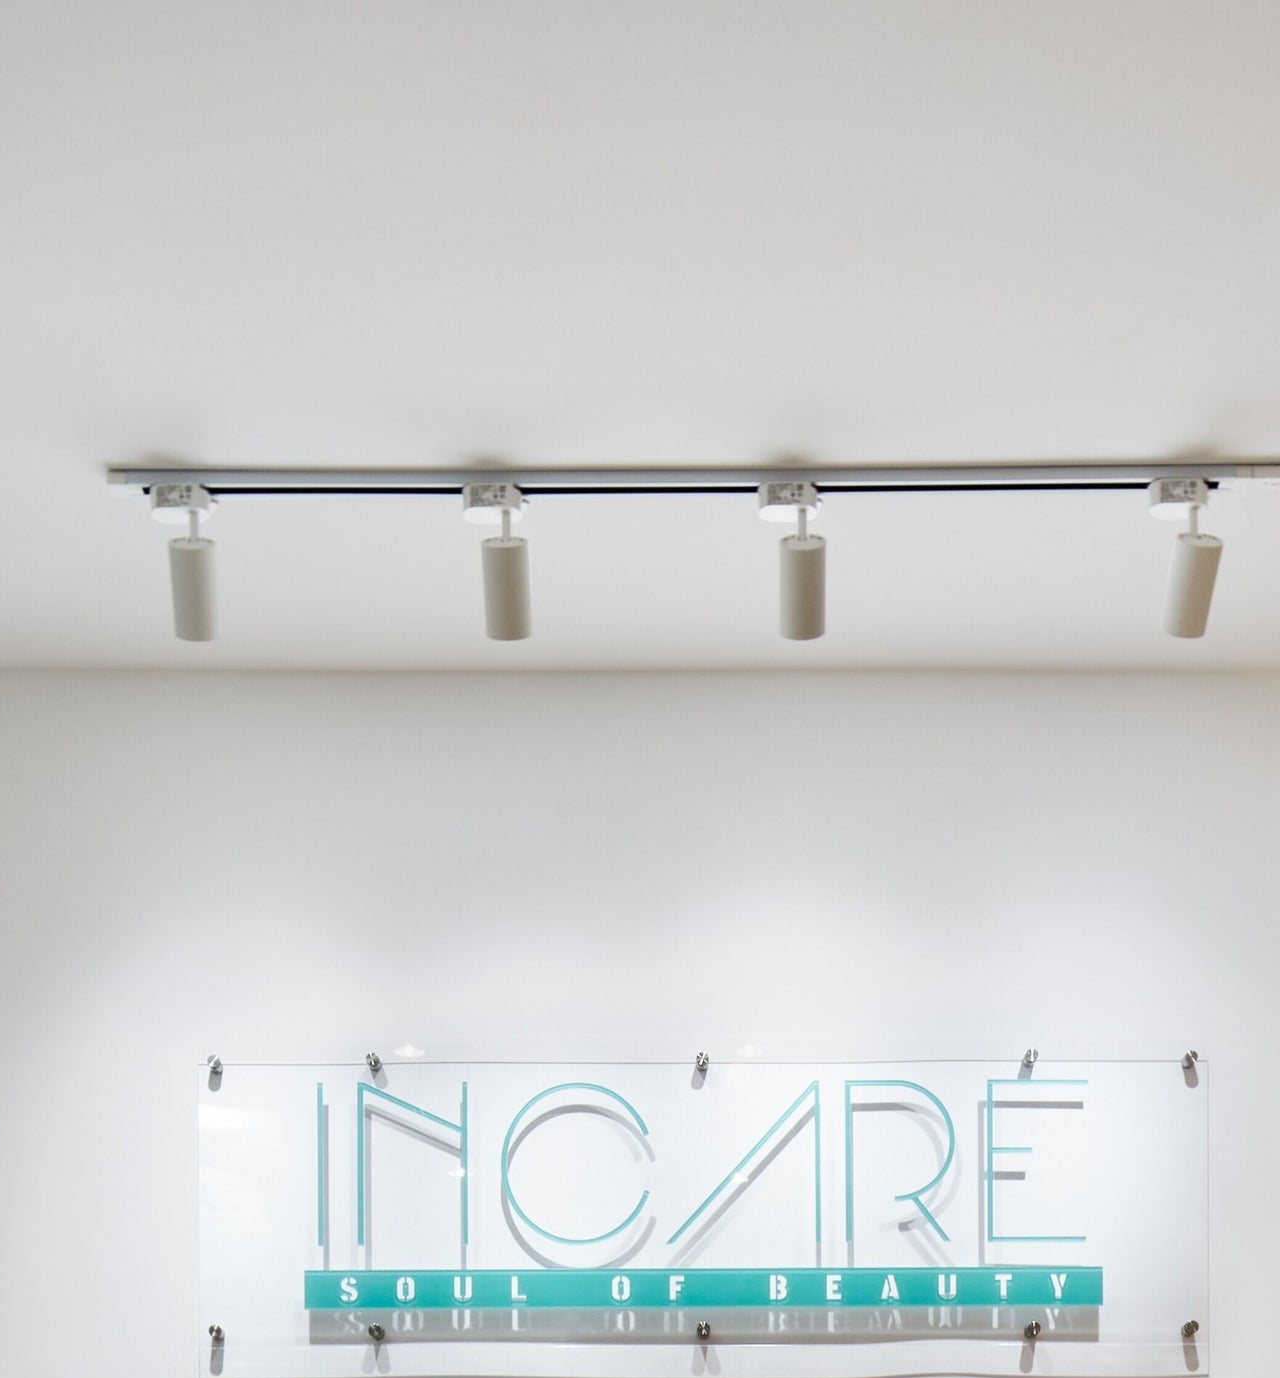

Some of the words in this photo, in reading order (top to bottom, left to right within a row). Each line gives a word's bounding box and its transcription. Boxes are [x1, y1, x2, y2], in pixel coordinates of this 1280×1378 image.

[317, 1080, 1088, 1246] INCARE
[340, 1275, 527, 1302] SOUL
[611, 1275, 685, 1301] OF
[769, 1272, 1067, 1301] BEAUTY
